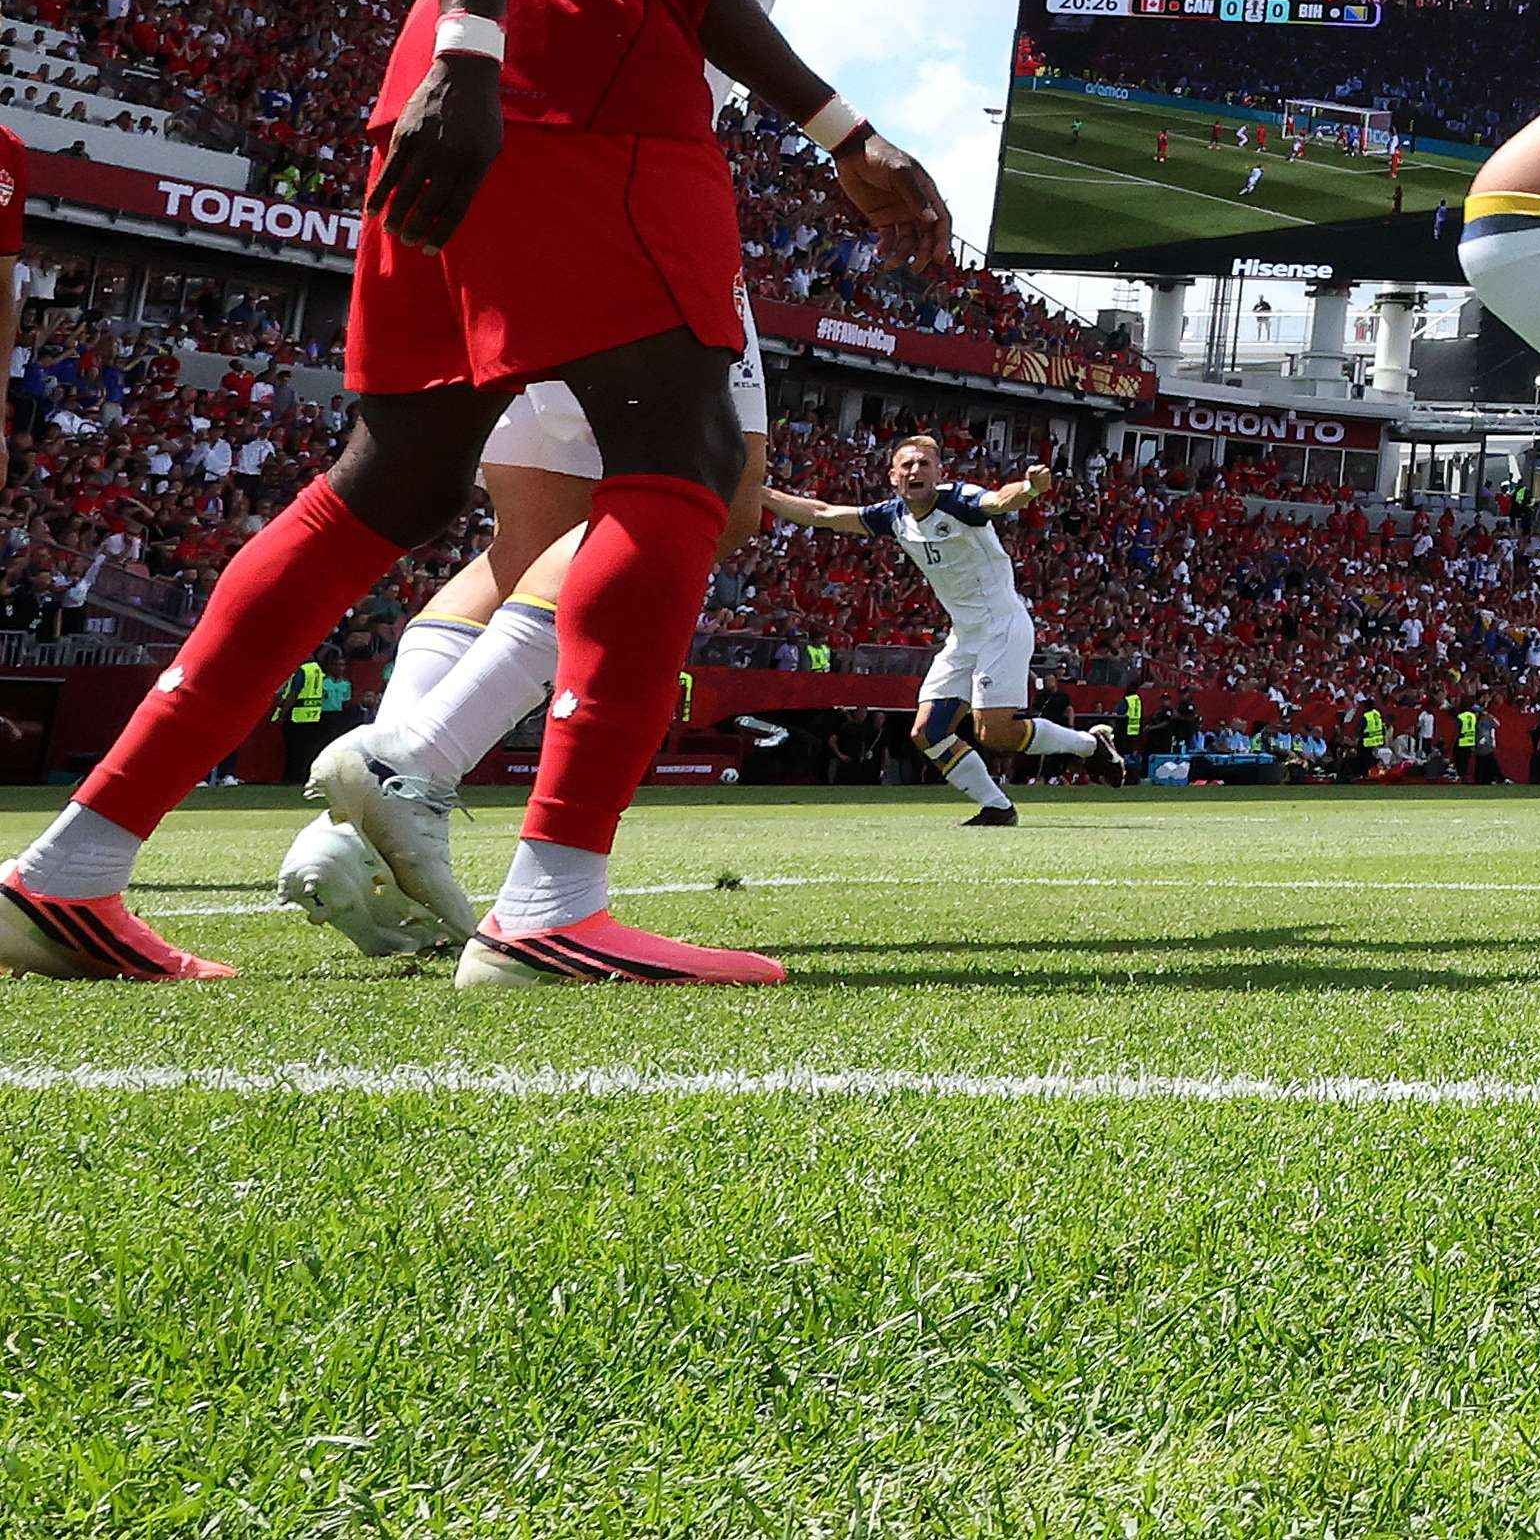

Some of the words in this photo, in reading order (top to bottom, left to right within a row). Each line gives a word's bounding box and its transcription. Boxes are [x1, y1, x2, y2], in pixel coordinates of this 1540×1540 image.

[1298, 3, 1323, 19] BIH
[157, 180, 363, 250] TORONT
[1231, 258, 1334, 279] Hisense
[816, 316, 897, 356] #FIFAWorldCup
[1168, 403, 1346, 444] TORONTO
[922, 541, 942, 565] 15
